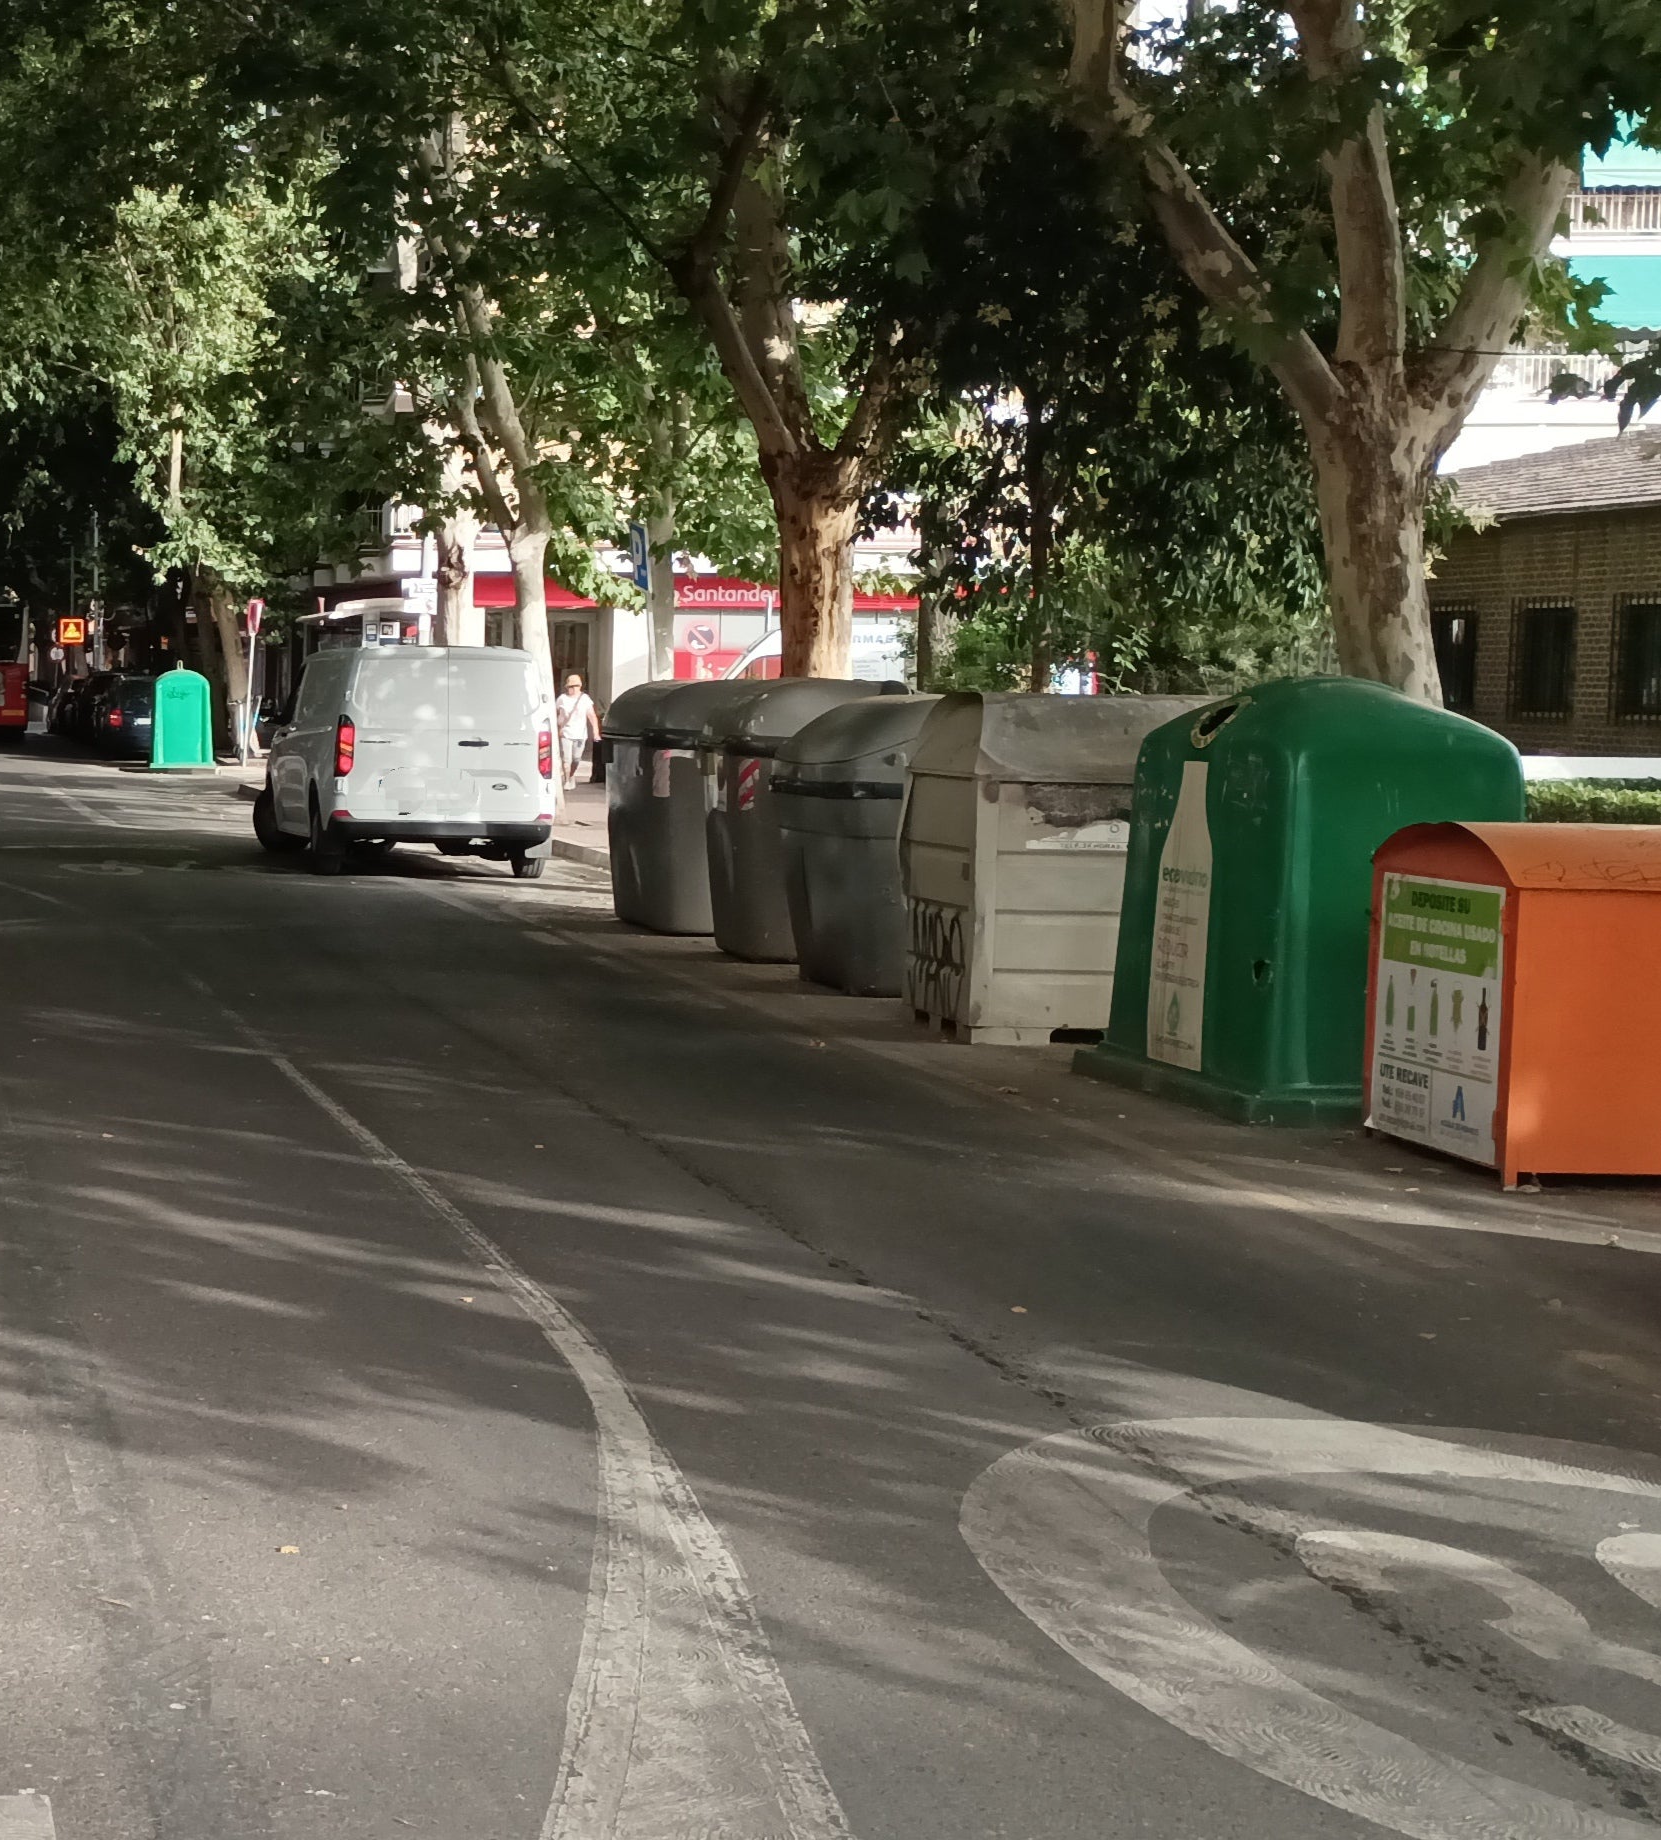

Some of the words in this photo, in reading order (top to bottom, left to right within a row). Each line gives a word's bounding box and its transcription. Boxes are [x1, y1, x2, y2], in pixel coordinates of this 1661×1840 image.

[683, 585, 780, 602] Santander
[1411, 890, 1456, 913] DEPOSITE
[1457, 896, 1472, 915] SU
[1416, 916, 1429, 933] DE
[1429, 918, 1463, 939] COCINA
[1464, 923, 1497, 944] USADO
[1409, 940, 1422, 956] EN
[1423, 942, 1467, 965] BOTELLAS
[1379, 1063, 1395, 1080] UTE
[1396, 1067, 1429, 1090] RECAVE
